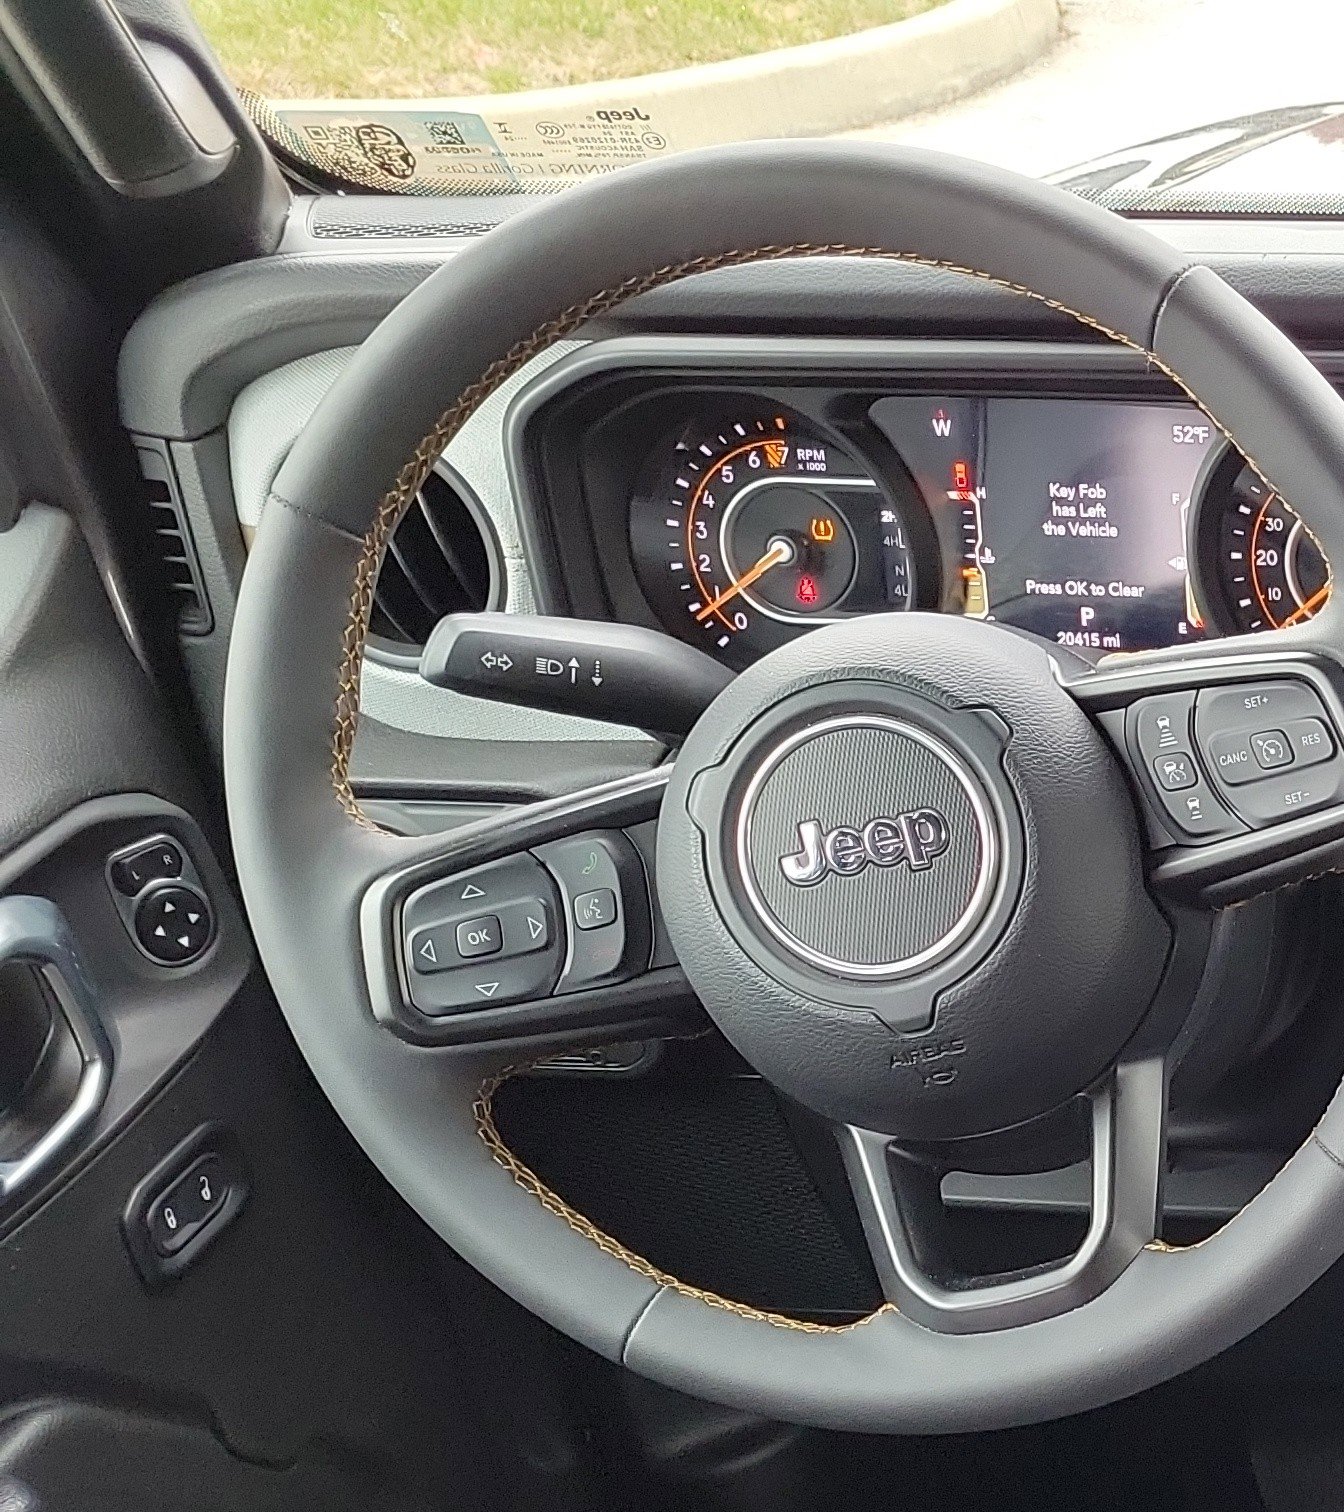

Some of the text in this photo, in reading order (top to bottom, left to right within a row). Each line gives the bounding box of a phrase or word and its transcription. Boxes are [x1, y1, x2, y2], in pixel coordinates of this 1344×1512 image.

[932, 418, 951, 437] W
[748, 451, 761, 468] 6
[778, 447, 789, 465] 7
[797, 449, 825, 461] RPM
[721, 466, 734, 483] 5
[806, 462, 826, 471] 1000
[703, 490, 715, 508] 4
[1049, 483, 1107, 501] Key Fob
[1052, 502, 1107, 519] has Left
[695, 521, 708, 539] 3
[1042, 521, 1119, 538] the Vehicle
[1265, 517, 1284, 532] 30
[699, 554, 711, 572] 2
[1256, 550, 1278, 566] 20
[1025, 580, 1145, 598] Press OK to Clear
[1267, 587, 1282, 600] 10
[734, 612, 748, 630] 0
[1080, 607, 1095, 627] P
[1178, 623, 1187, 634] E
[1057, 631, 1120, 648] 20415 mi
[1302, 732, 1320, 746] RES
[1220, 750, 1248, 766] CANC
[780, 807, 950, 886] Jeep
[163, 854, 173, 866] R
[467, 928, 491, 945] OK
